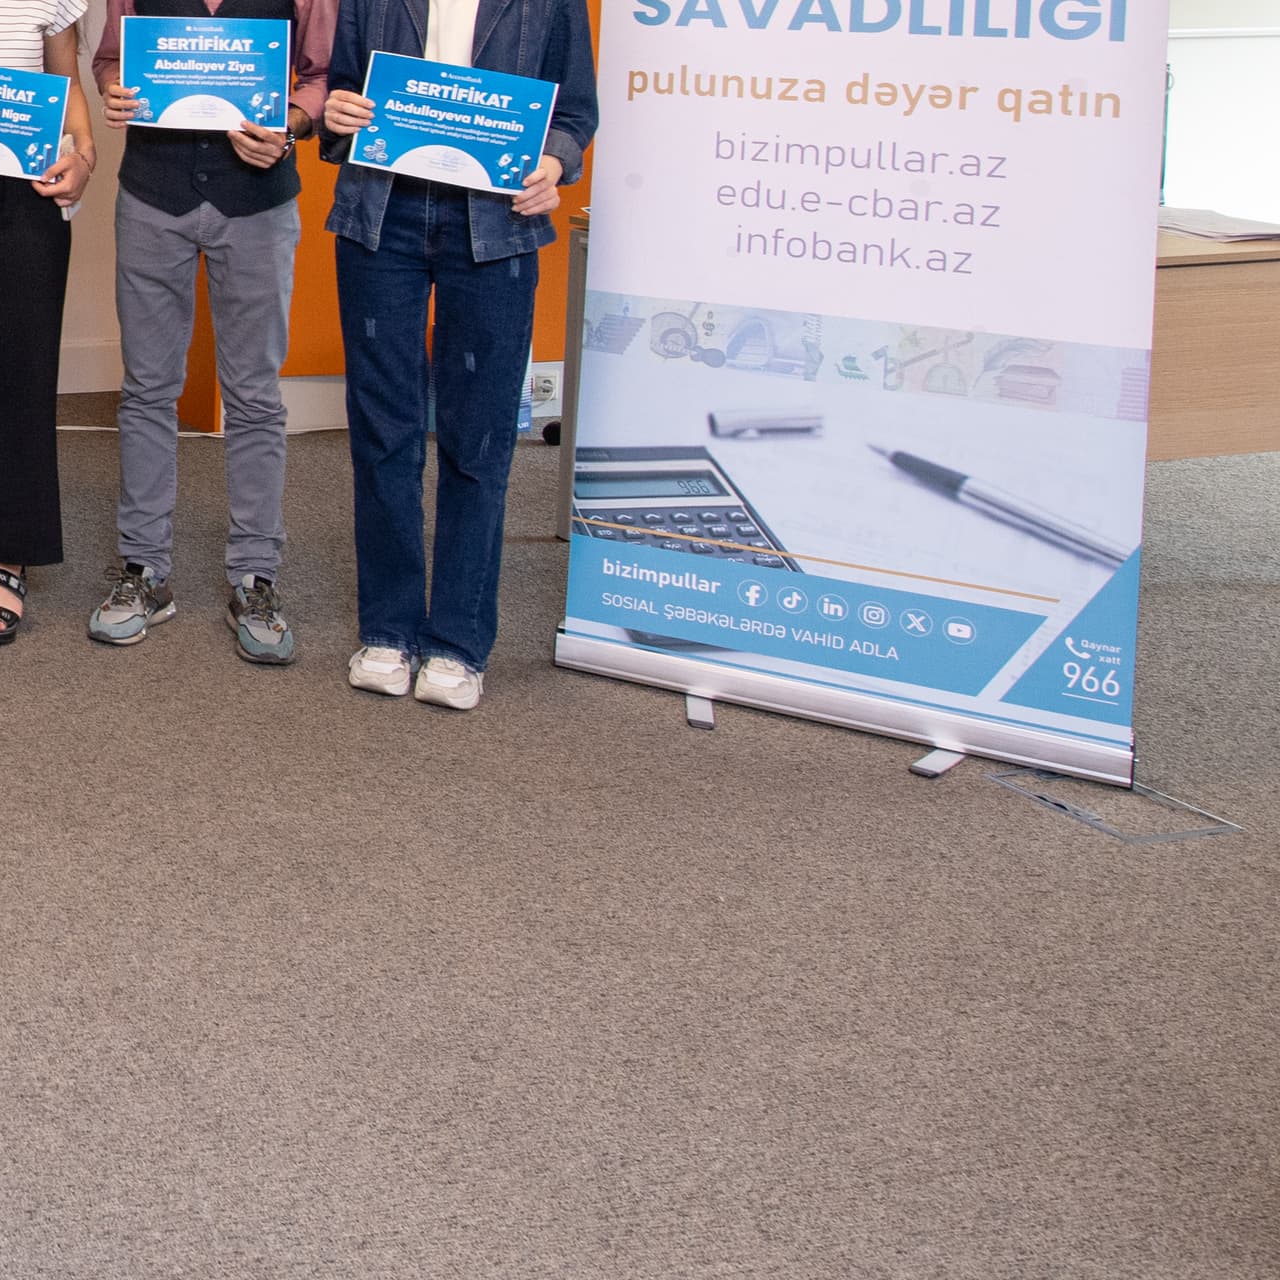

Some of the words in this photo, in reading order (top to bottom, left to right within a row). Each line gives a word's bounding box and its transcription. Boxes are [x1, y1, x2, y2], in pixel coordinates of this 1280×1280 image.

[157, 35, 254, 52] SERTİFİKAT
[154, 59, 226, 73] Abdullayev
[227, 60, 255, 74] Ziya
[405, 79, 512, 109] SERTİFİKAT
[626, 66, 827, 105] pulunuza
[844, 73, 979, 116] dəyər
[996, 87, 1122, 123] qatın
[2, 110, 32, 122] Nigar
[384, 99, 471, 123] Abdullayeva
[474, 115, 525, 133] Nərmin
[713, 131, 1008, 179] bizimpullar.az
[716, 181, 1002, 228] edu.e-cbar.az
[735, 226, 973, 275] infobank.az
[677, 479, 710, 495] 966
[603, 558, 721, 595] bizimpullar
[663, 604, 787, 639] ŞƏBƏKƏLƏRDƏ
[849, 640, 899, 660] ADLA
[1080, 639, 1122, 654] Qaynar
[1063, 662, 1120, 696] 966
